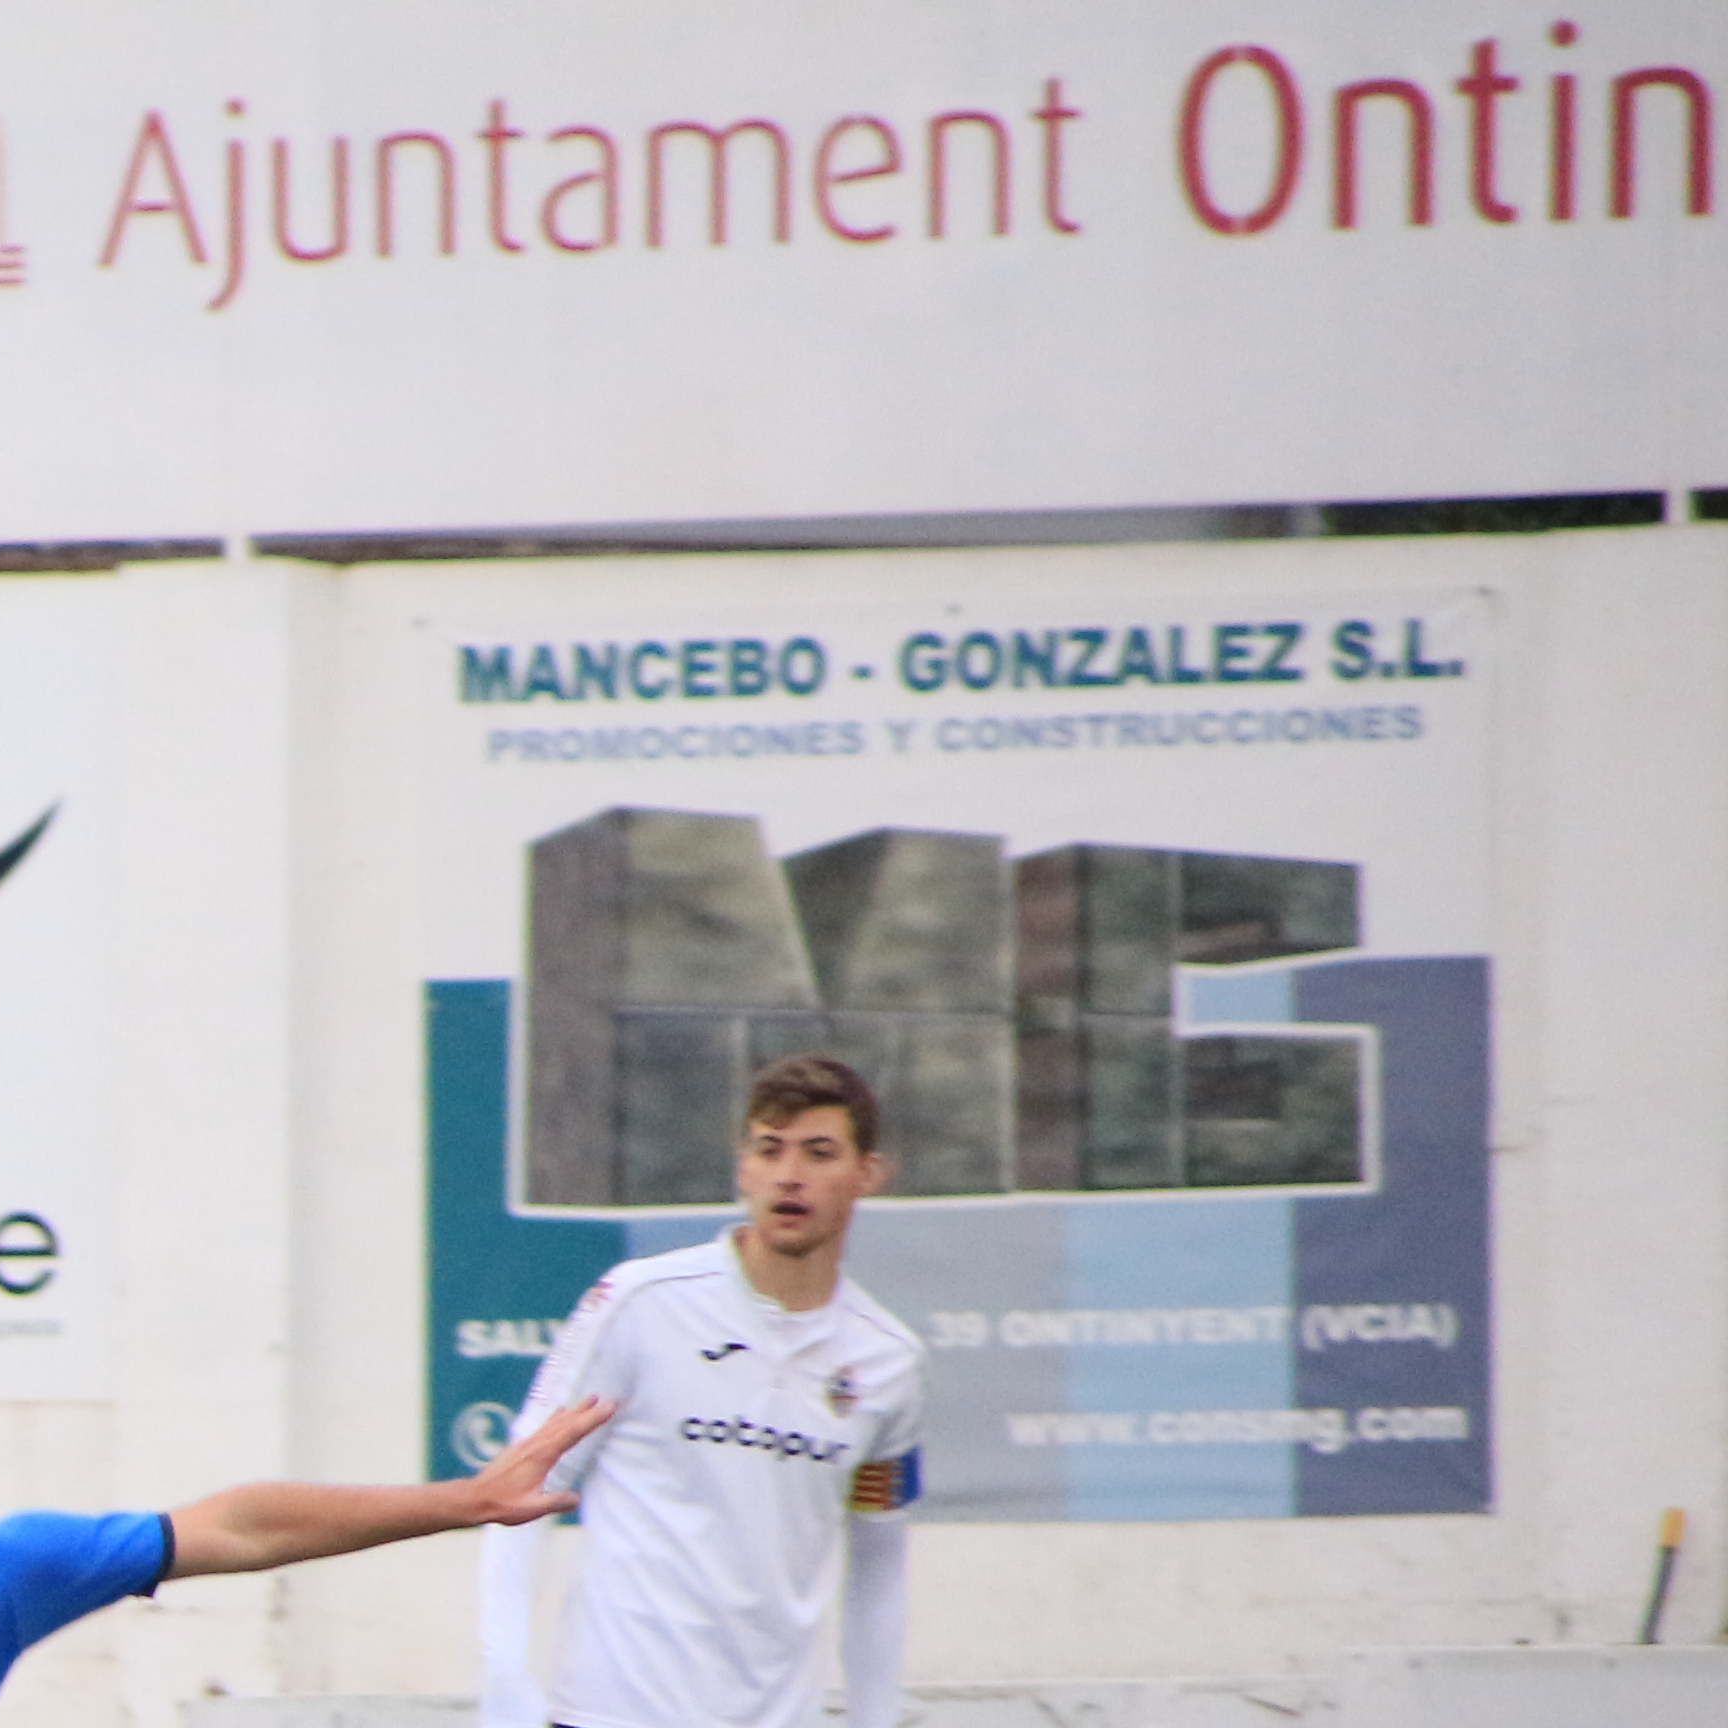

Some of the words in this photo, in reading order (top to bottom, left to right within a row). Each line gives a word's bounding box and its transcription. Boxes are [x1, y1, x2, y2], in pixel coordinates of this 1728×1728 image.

[98, 76, 1086, 312] Ajuntament
[459, 637, 827, 703] MANCEBO
[899, 621, 1305, 694] GONZALEZ
[1331, 619, 1465, 682] S.L.
[487, 719, 866, 764] PROMOCIONES
[886, 718, 917, 754] Y
[933, 703, 1428, 756] CONSTRUCCIONES
[999, 1305, 1292, 1347] ONTINYENT
[1300, 1303, 1458, 1351] (VCIA)
